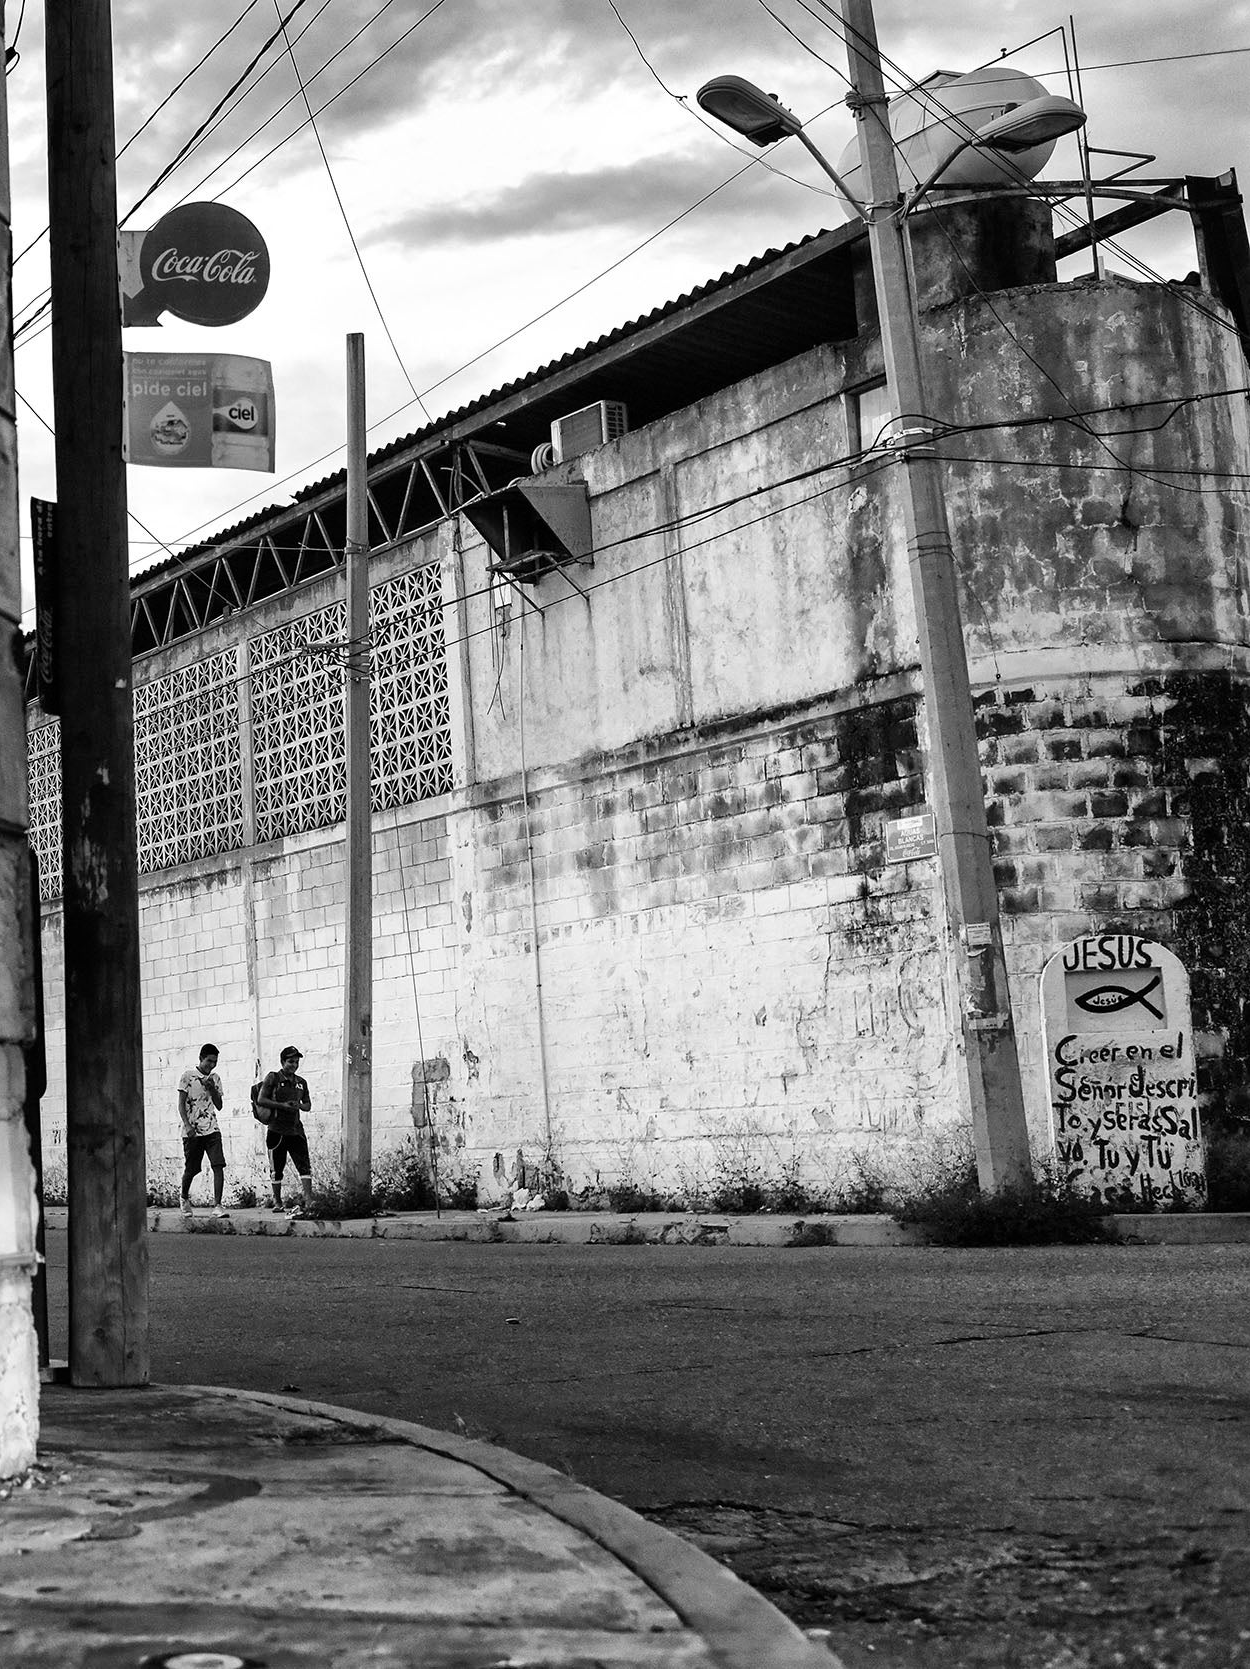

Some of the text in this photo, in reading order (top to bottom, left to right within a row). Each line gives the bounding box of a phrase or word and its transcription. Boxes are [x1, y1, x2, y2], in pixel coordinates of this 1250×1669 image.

[151, 248, 261, 284] Coca-Cola
[132, 381, 207, 398] pide ciel
[228, 404, 255, 421] ciel
[1063, 936, 1153, 971] JESUS
[1126, 1045, 1152, 1060] en
[1159, 1031, 1183, 1059] el
[1123, 1143, 1140, 1176] y
